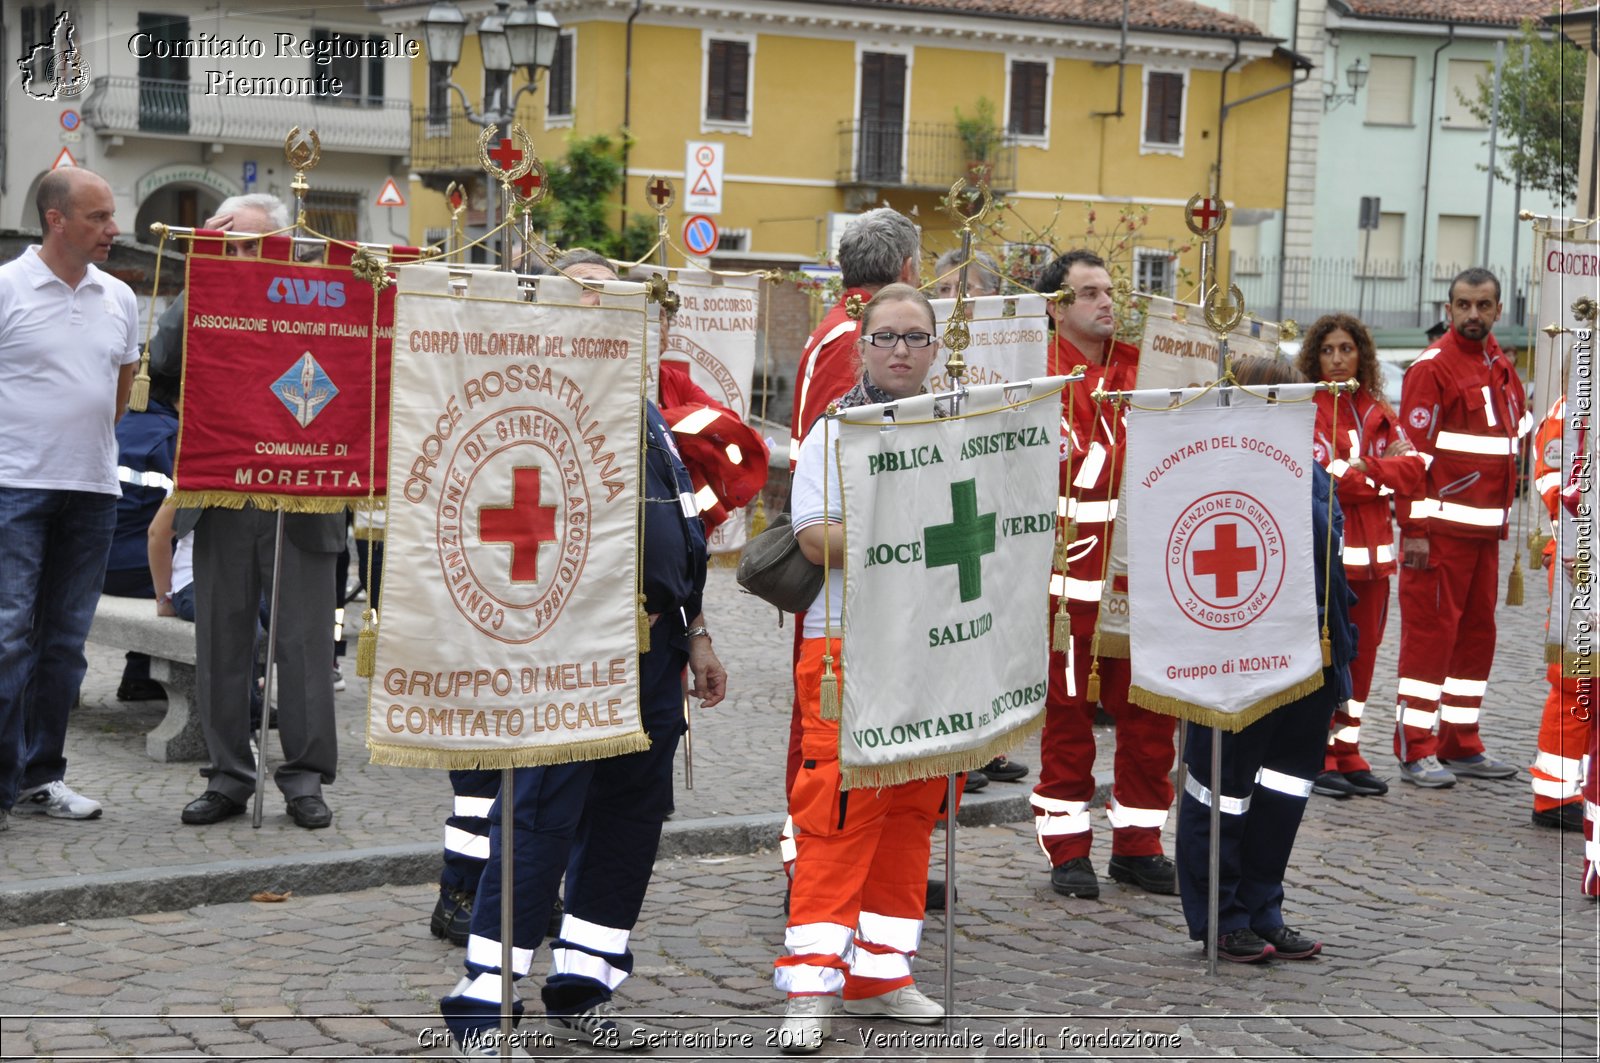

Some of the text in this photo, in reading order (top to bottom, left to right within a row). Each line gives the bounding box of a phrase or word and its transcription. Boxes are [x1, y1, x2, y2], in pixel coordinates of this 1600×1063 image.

[266, 276, 346, 308] AVIS
[683, 296, 753, 312] DEL SOCCORSO
[192, 314, 268, 332] ASSOCIAZIONE
[272, 319, 327, 336] VOLONTARI
[329, 322, 368, 338] ITALIANI
[975, 332, 992, 346] DEL
[409, 330, 459, 355] CORPO
[463, 332, 540, 357] VOLONTARI
[544, 335, 567, 358] DEL
[696, 350, 740, 402] GINEVRA
[254, 441, 348, 457] COMUNALE DI
[403, 364, 625, 504] CROCE ROSSA ITALIANA
[234, 468, 362, 488] MORETTA
[1141, 436, 1304, 489] VOLONTARI DEL SOCCORSO
[441, 414, 586, 631] CONVENZIONE DI GINEVRA 22 AGOSTO 1864
[1171, 497, 1279, 565] CONVENZIONE DI GINEVRA
[1185, 591, 1268, 624] 22 AGOSTO 1864
[383, 658, 627, 698] GRUPPO DI MELLE
[1166, 654, 1292, 680] Gruppo di MONTA'
[386, 698, 624, 737] COMITATO LOCALE
[852, 712, 974, 749] VOLONTARI
